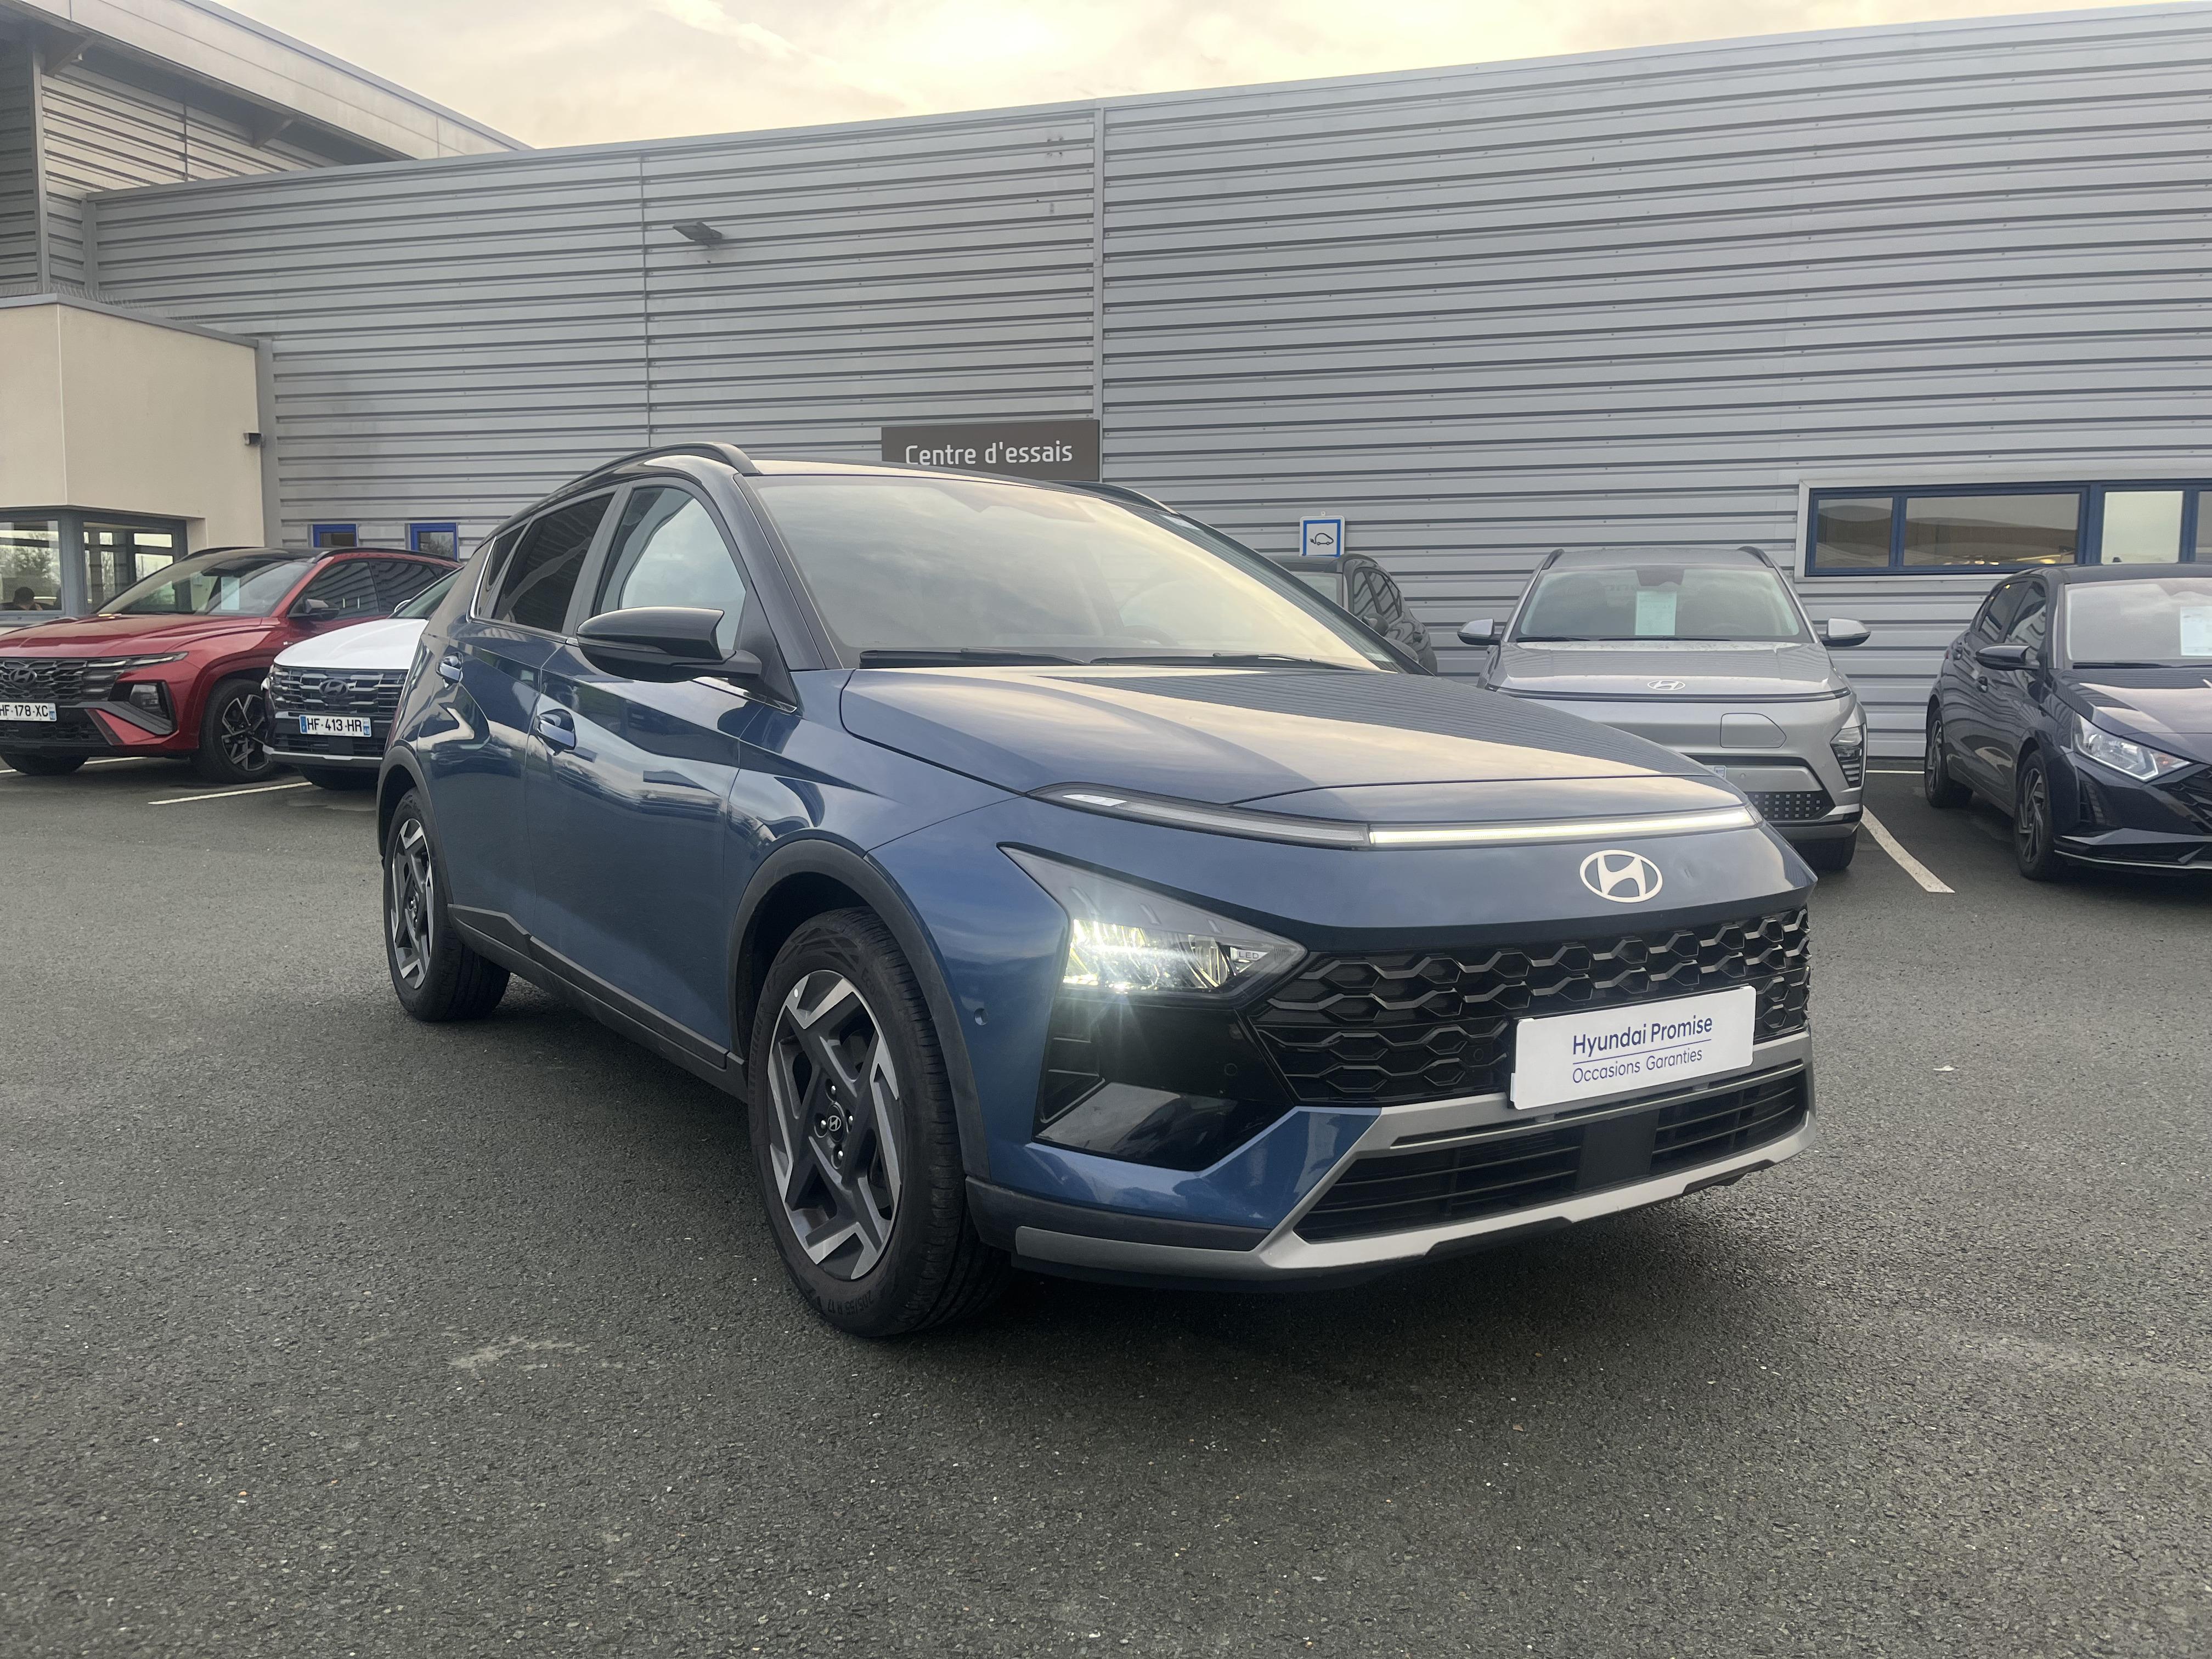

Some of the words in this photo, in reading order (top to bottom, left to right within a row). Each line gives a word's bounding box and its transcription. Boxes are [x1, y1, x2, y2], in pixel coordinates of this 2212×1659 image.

[906, 444, 976, 465] Centre
[985, 440, 1073, 464] d'essais
[307, 718, 362, 732] HF-413-HR
[1573, 1024, 1646, 1057] Hyundai
[1651, 1015, 1713, 1041] Promise
[1572, 1059, 1640, 1084] Occasions
[1646, 1048, 1703, 1071] Garanties
